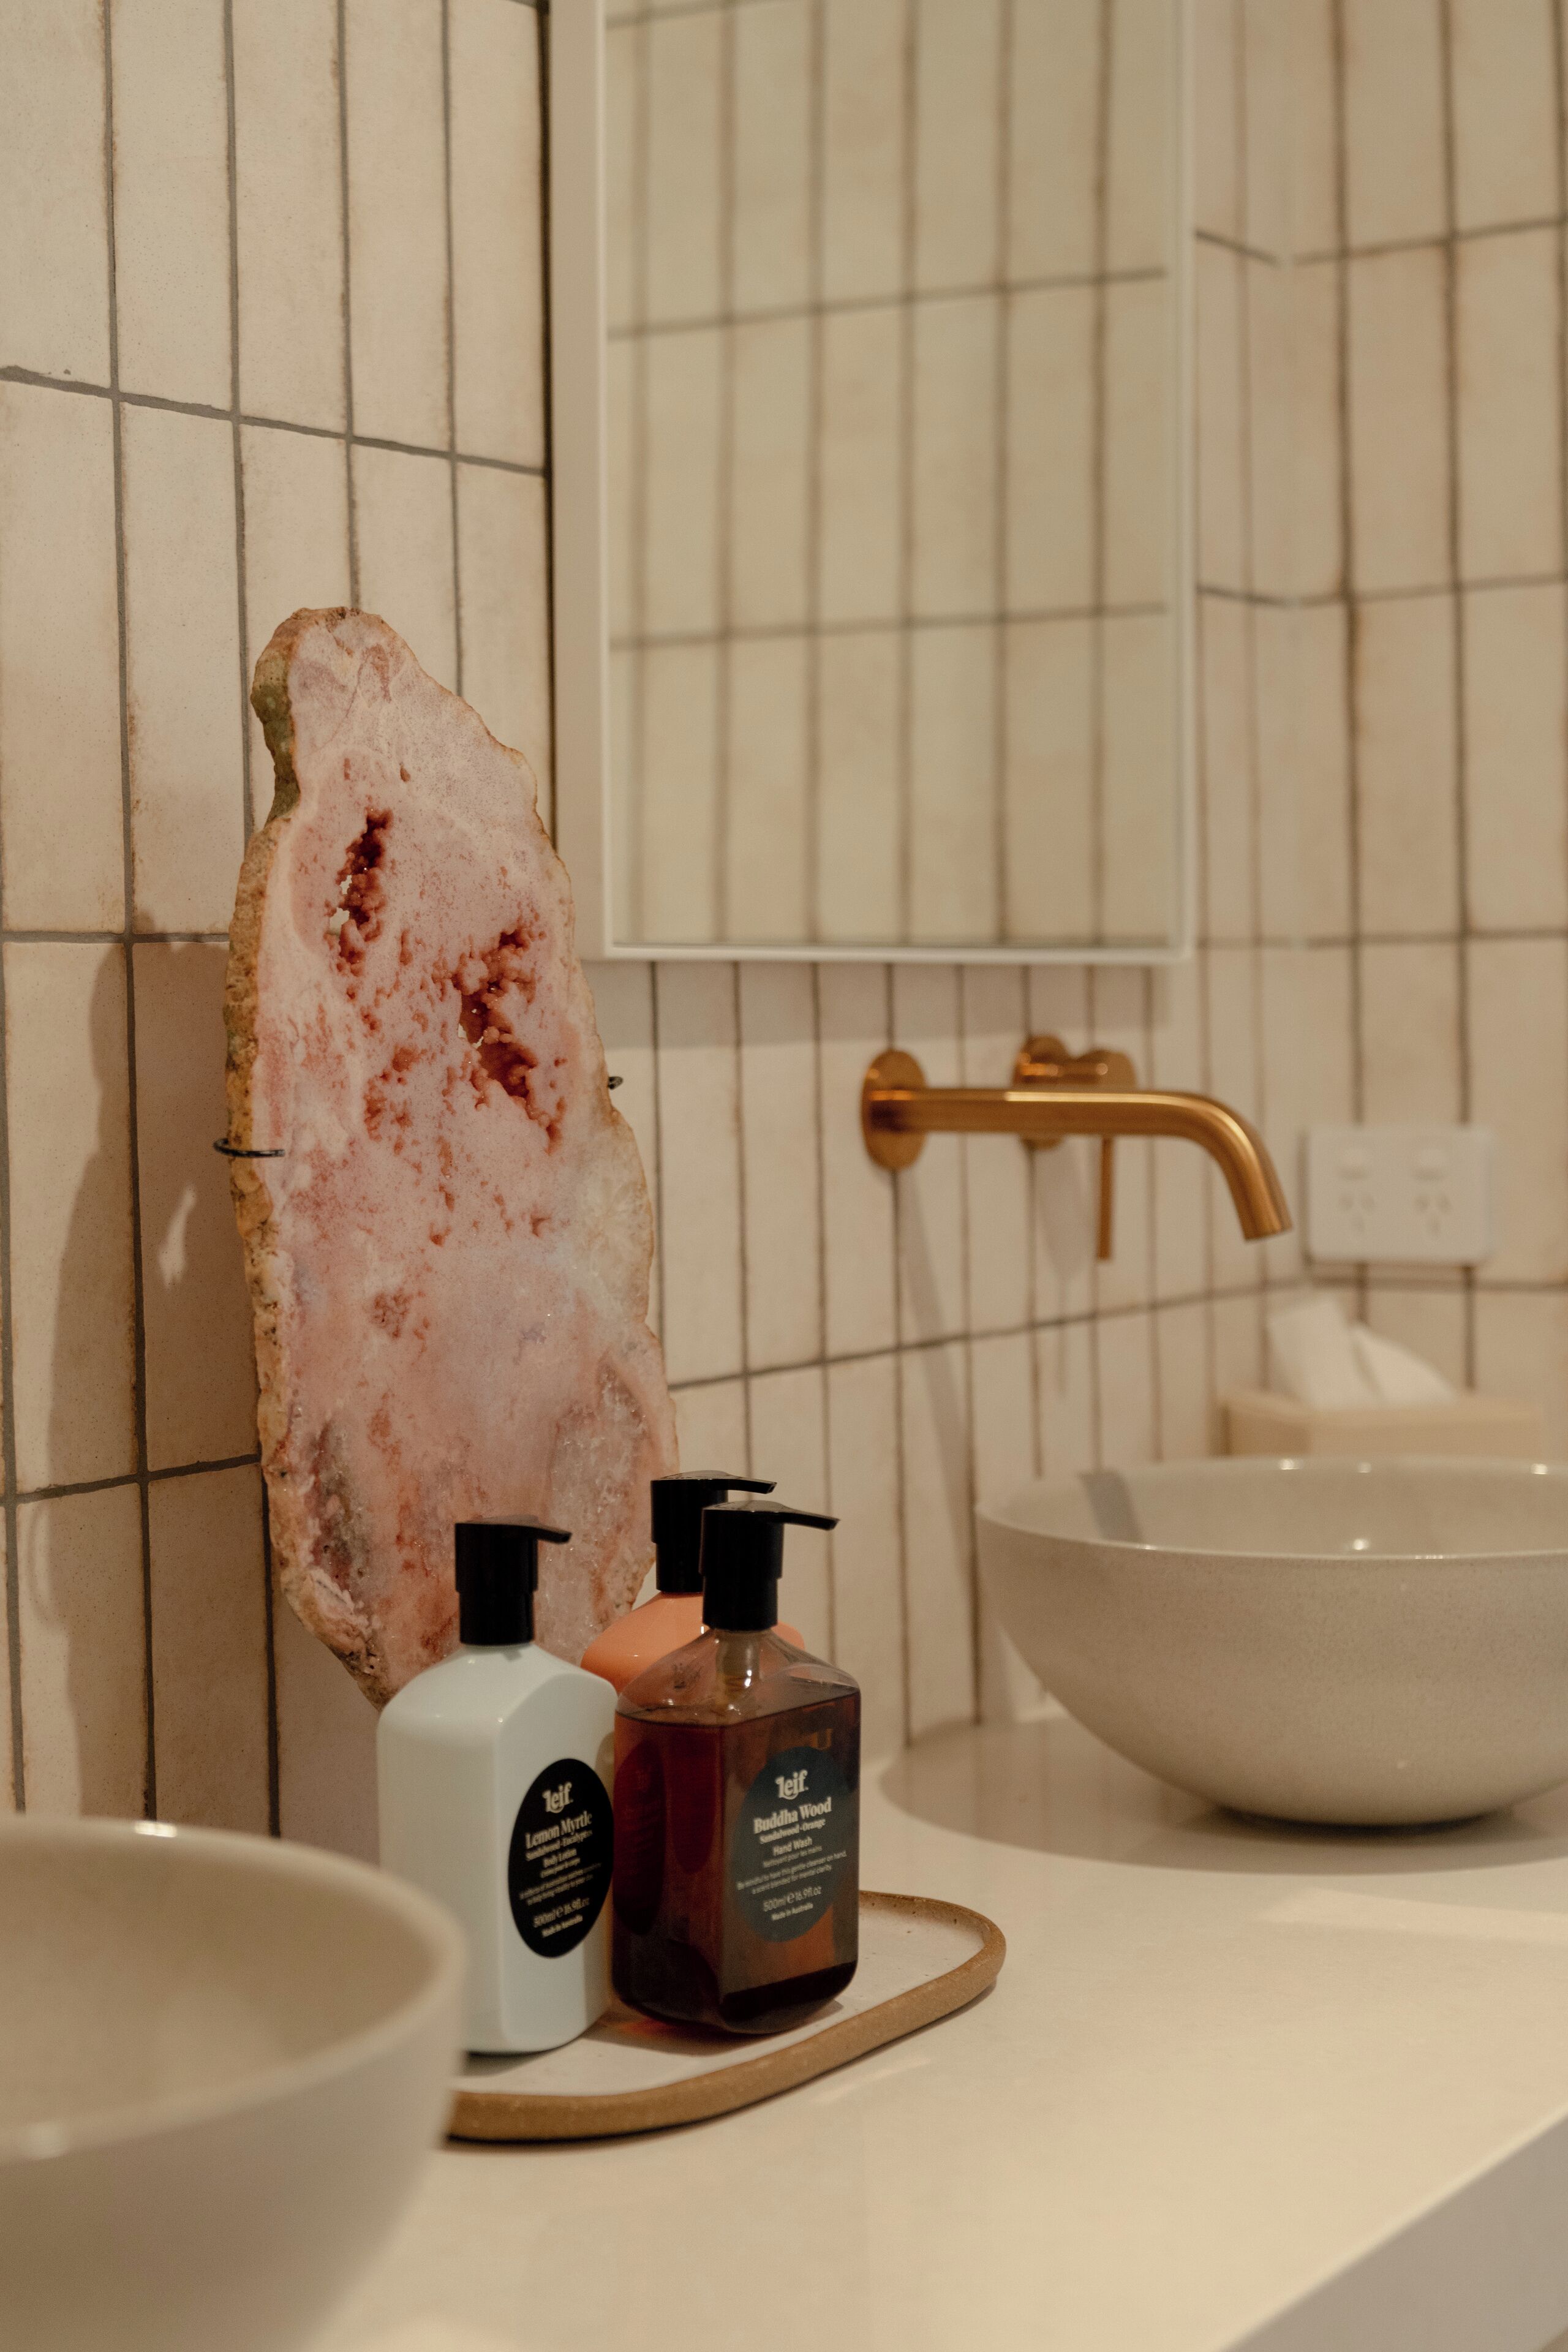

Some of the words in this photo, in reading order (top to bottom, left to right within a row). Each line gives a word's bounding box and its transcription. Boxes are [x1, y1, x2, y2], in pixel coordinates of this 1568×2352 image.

[753, 1809, 798, 1834] Buddha
[799, 1796, 832, 1819] Wood
[525, 1825, 560, 1849] Lemon
[560, 1810, 592, 1835] Myrtle
[760, 1823, 800, 1844] Sandalwood
[802, 1819, 826, 1832] Orange
[773, 1841, 792, 1856] Hand
[793, 1836, 813, 1850] Wash
[763, 1896, 786, 1912] 500ml
[792, 1902, 813, 1914] Australia
